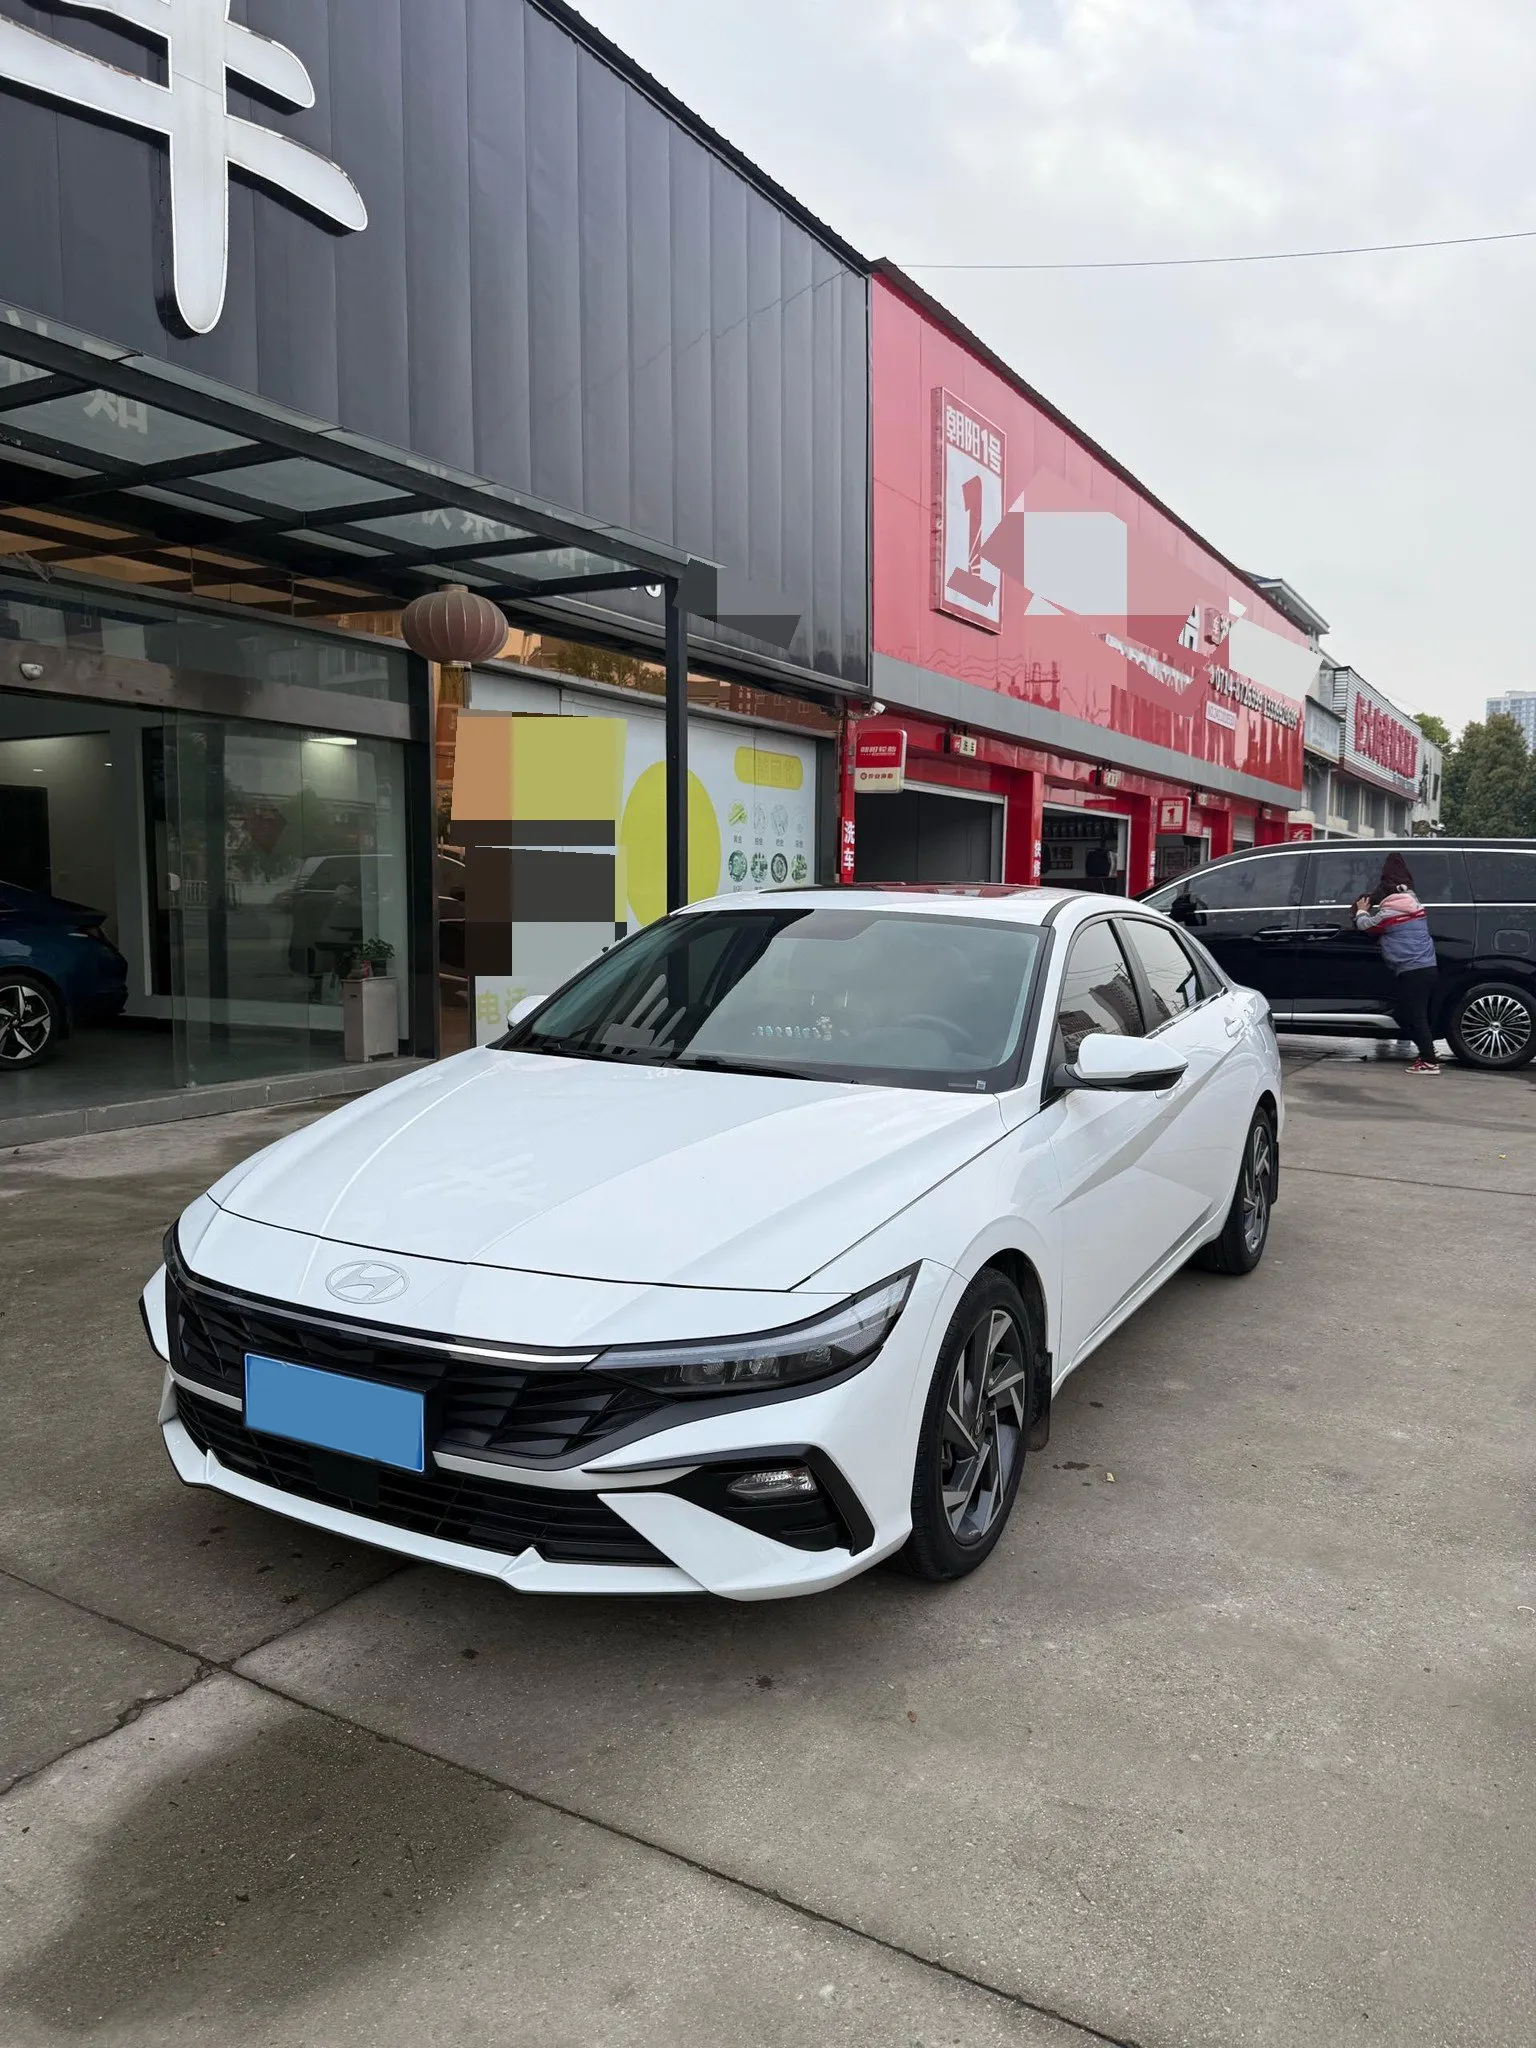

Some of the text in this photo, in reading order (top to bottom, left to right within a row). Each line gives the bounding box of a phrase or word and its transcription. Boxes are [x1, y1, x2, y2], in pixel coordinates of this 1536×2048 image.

[946, 405, 1002, 474] 朝阳1号
[844, 821, 855, 870] 洗车
